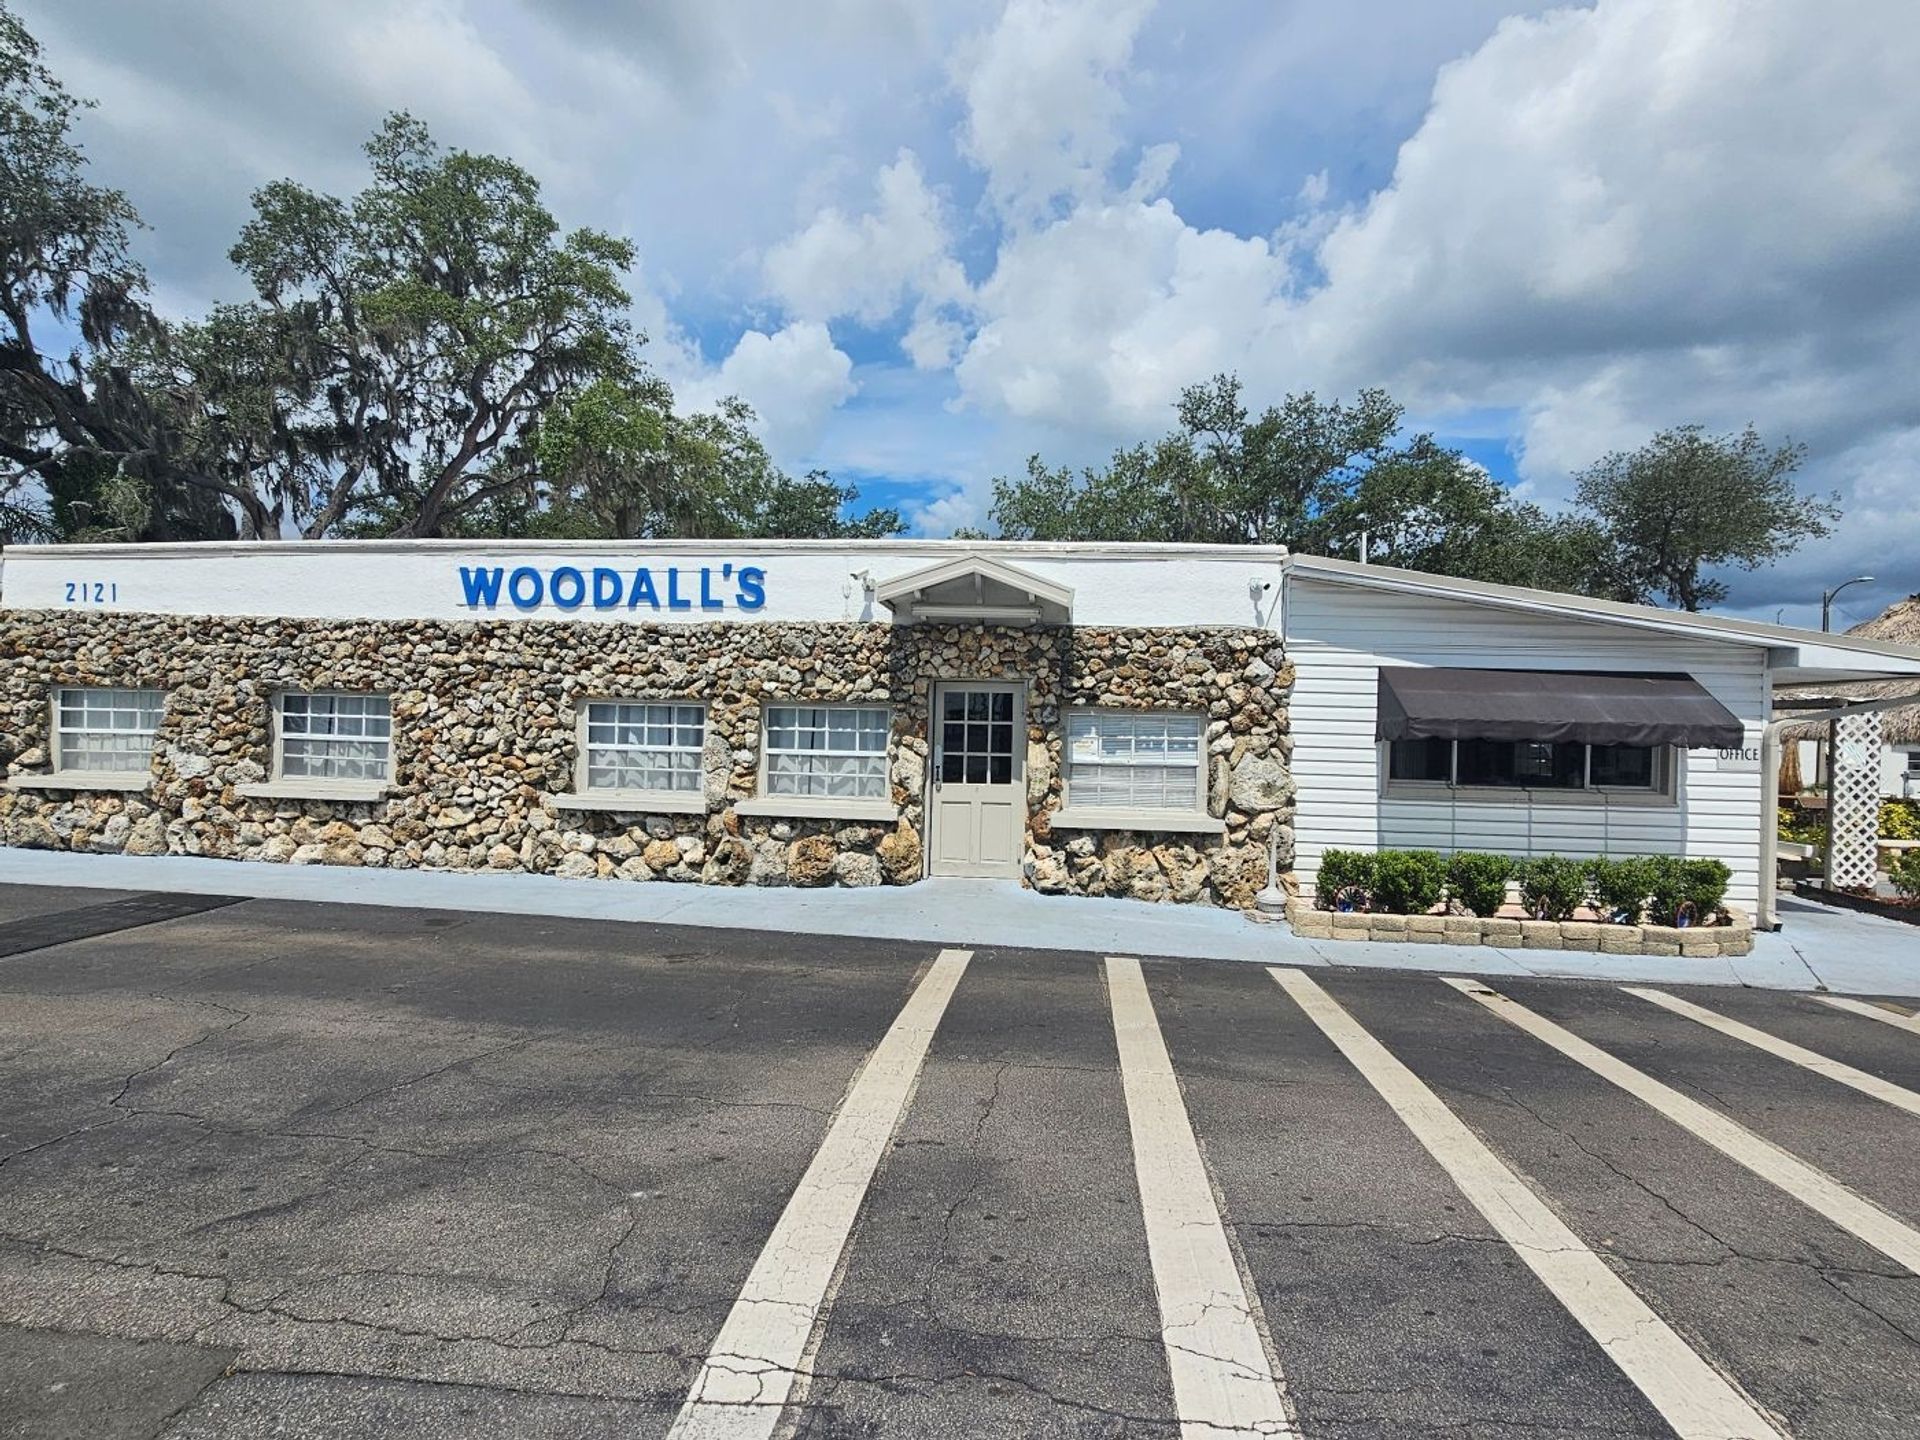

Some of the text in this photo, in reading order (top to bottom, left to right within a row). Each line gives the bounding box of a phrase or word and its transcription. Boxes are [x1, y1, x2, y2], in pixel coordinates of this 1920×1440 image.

[65, 582, 116, 602] 2121
[460, 564, 766, 609] WOODALL'S
[1719, 748, 1759, 761] OFFICE
